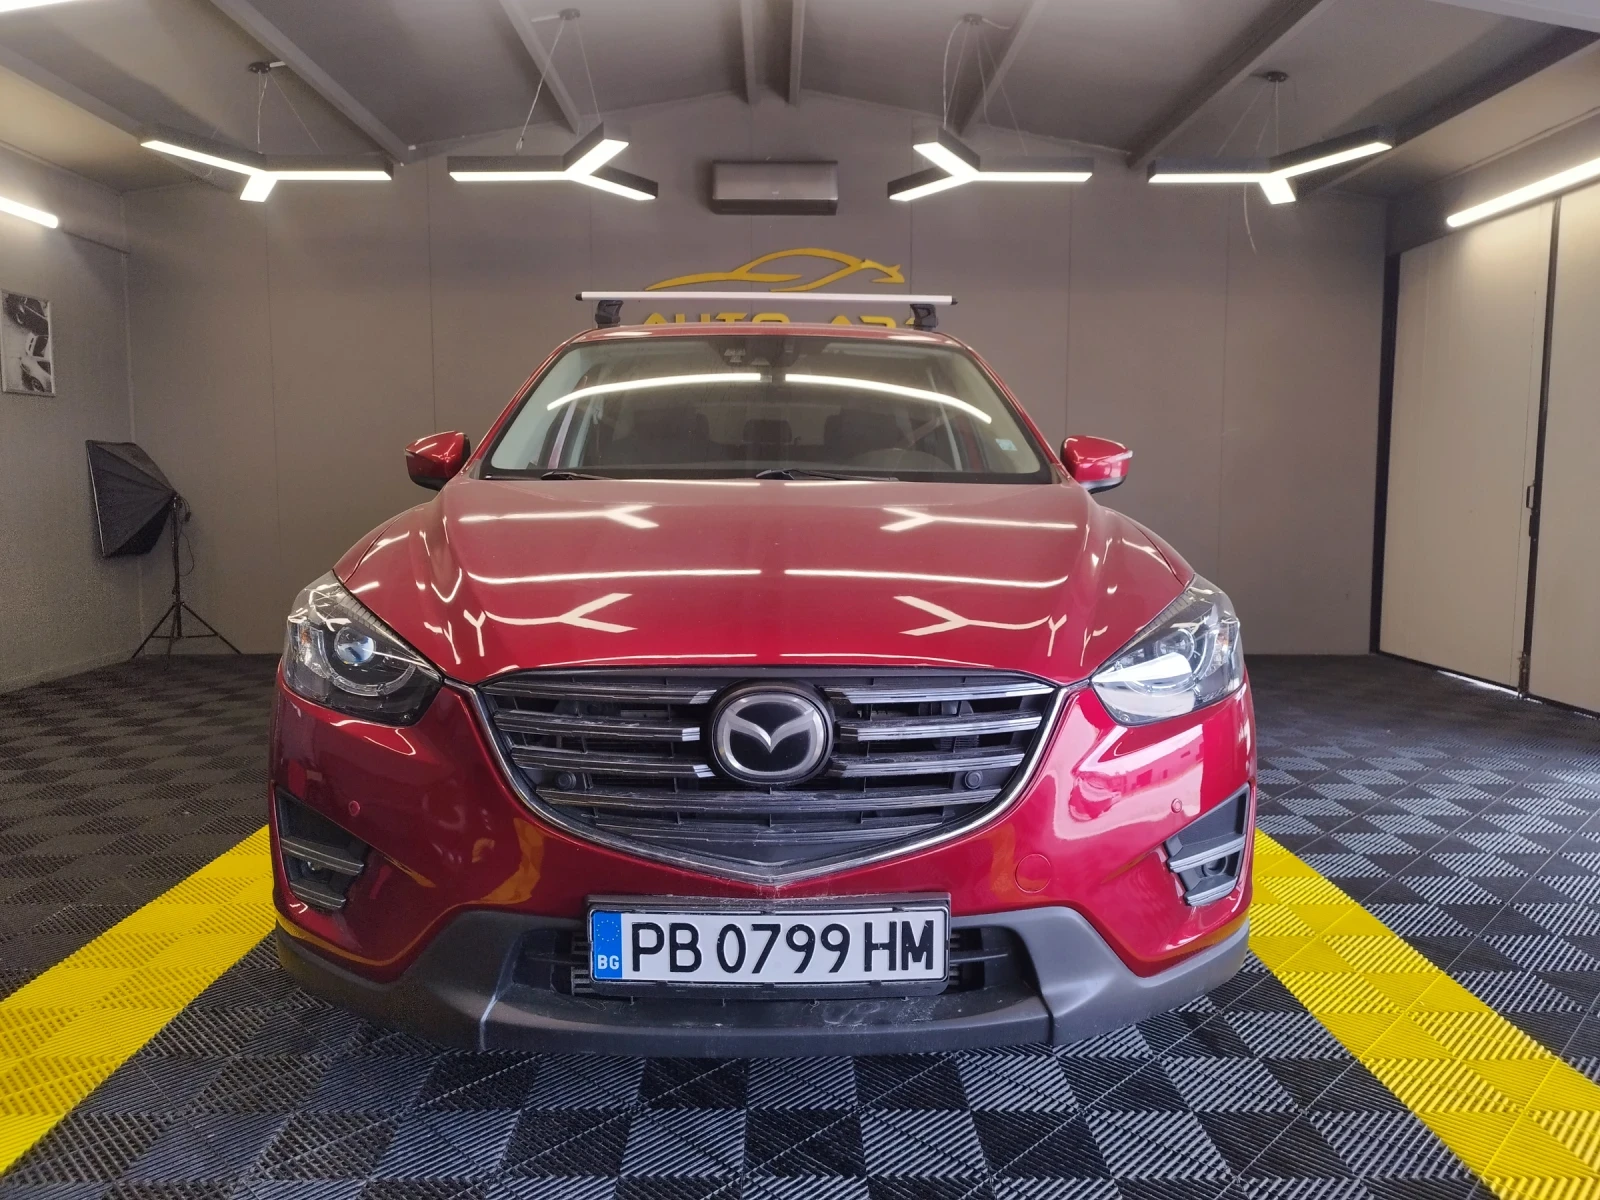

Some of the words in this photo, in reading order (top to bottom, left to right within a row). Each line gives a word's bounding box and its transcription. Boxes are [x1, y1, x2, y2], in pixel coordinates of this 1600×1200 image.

[597, 954, 620, 970] BG
[631, 921, 703, 973] PB
[716, 923, 851, 974] 0799
[863, 919, 934, 973] HM
